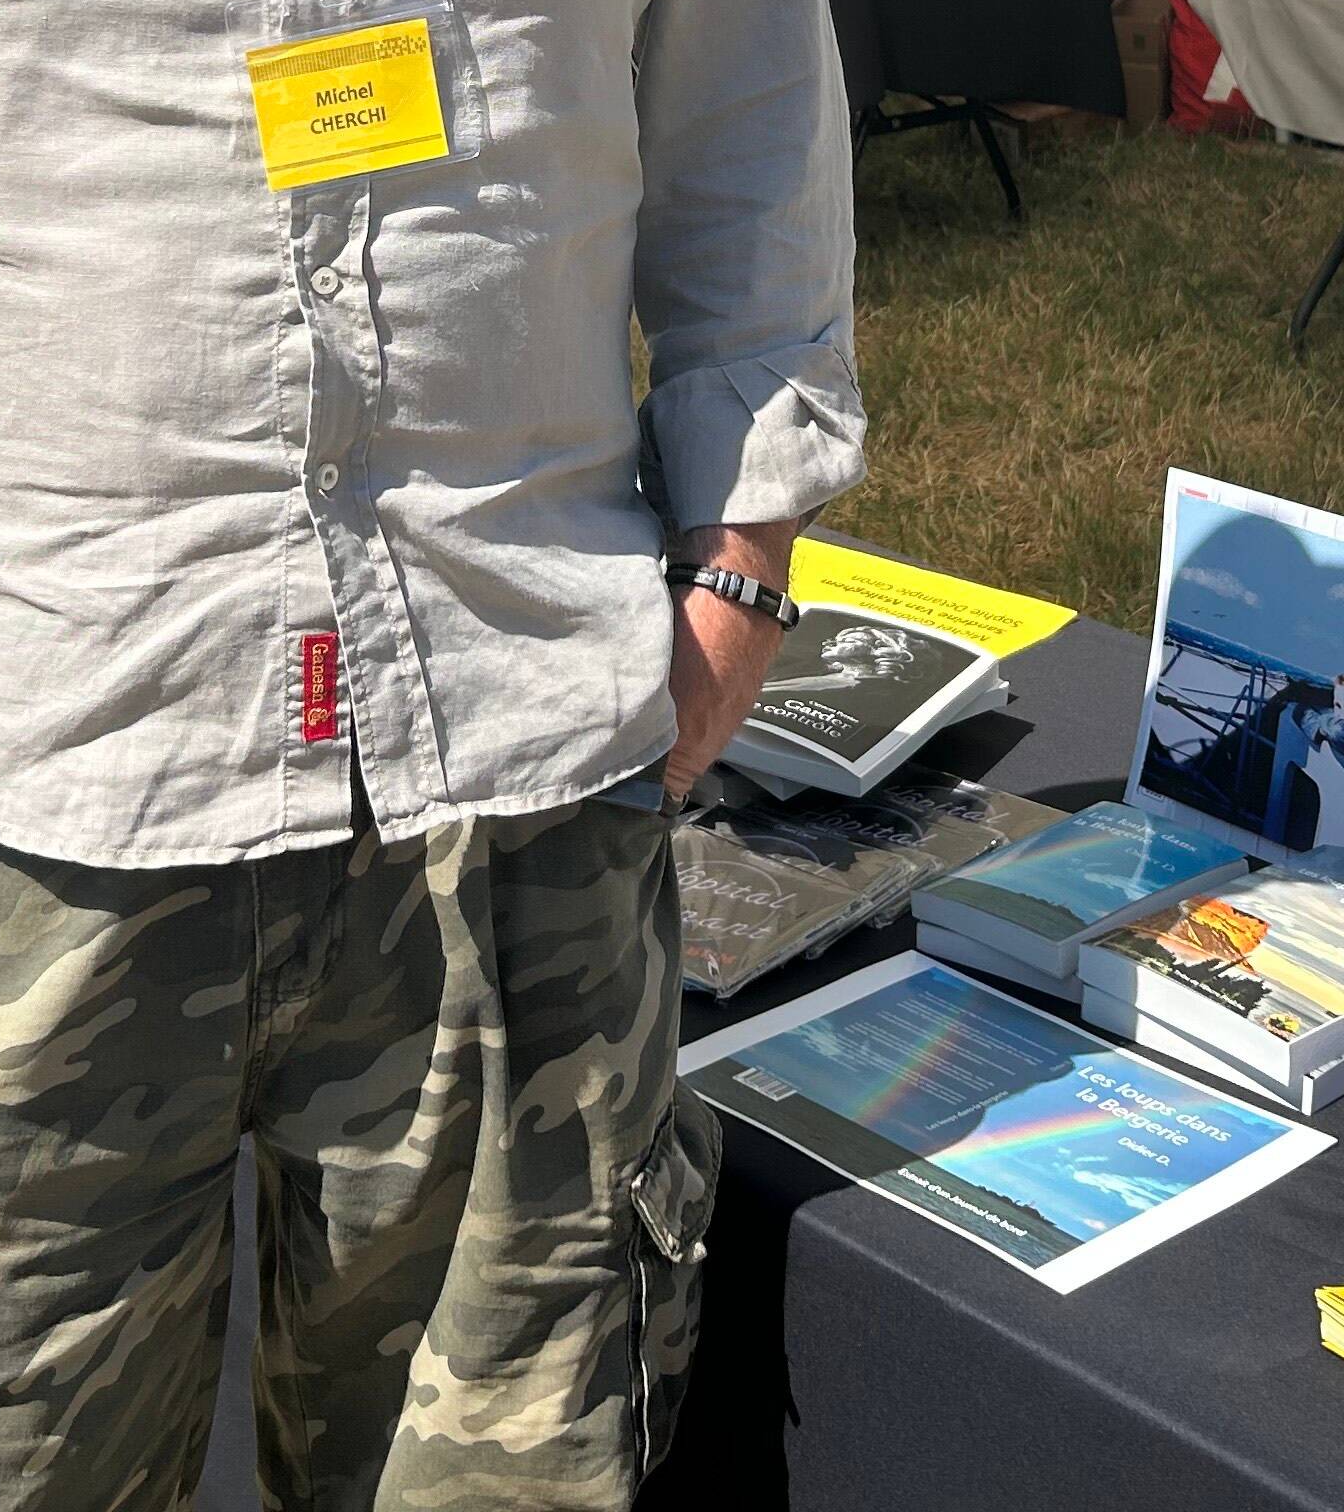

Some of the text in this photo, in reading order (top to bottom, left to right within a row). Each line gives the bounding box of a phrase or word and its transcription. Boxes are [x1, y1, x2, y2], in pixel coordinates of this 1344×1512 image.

[316, 81, 373, 108] Michel
[310, 106, 387, 135] CHERCHI
[904, 600, 934, 616] Van
[936, 611, 1007, 636] Sandrine
[784, 699, 852, 730] Garder
[1075, 1087, 1189, 1146] la Bergerie
[1077, 1065, 1117, 1089] Les
[1114, 1082, 1177, 1117] loups
[1175, 1112, 1233, 1142] dans
[1117, 1136, 1172, 1167] Didier D.
